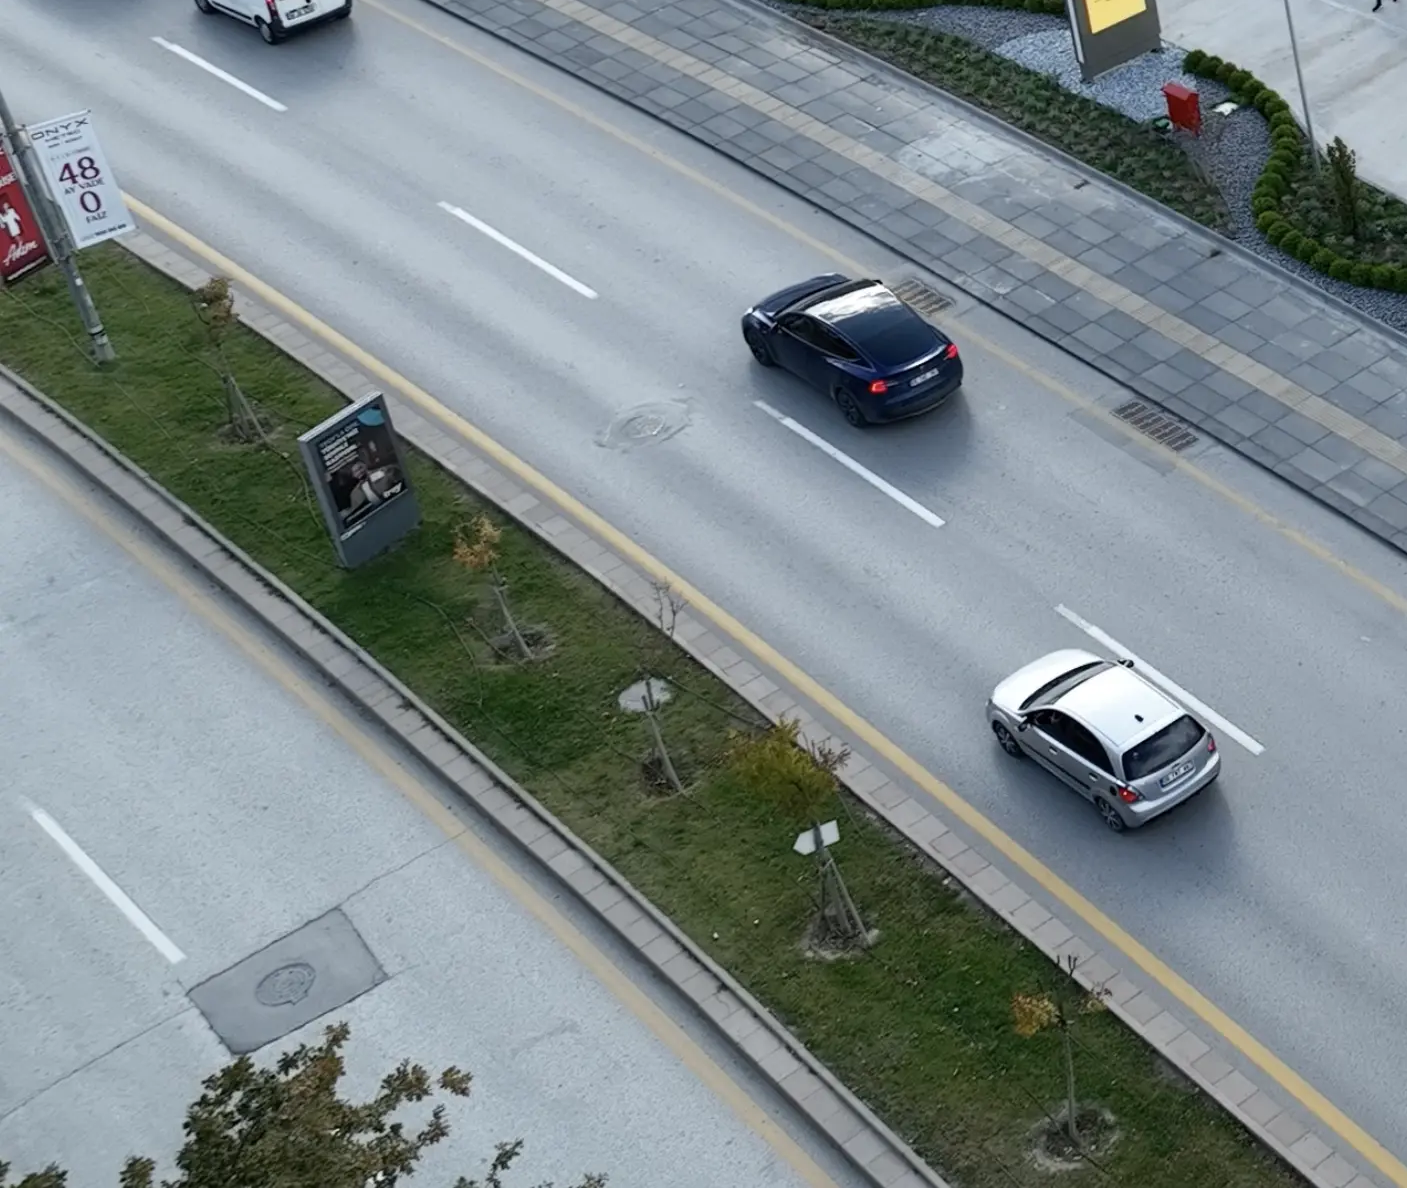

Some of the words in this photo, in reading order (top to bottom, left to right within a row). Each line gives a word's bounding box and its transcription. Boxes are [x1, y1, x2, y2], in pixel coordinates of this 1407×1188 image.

[31, 117, 89, 141] ONYX
[59, 156, 100, 185] 48
[79, 191, 102, 214] 0
